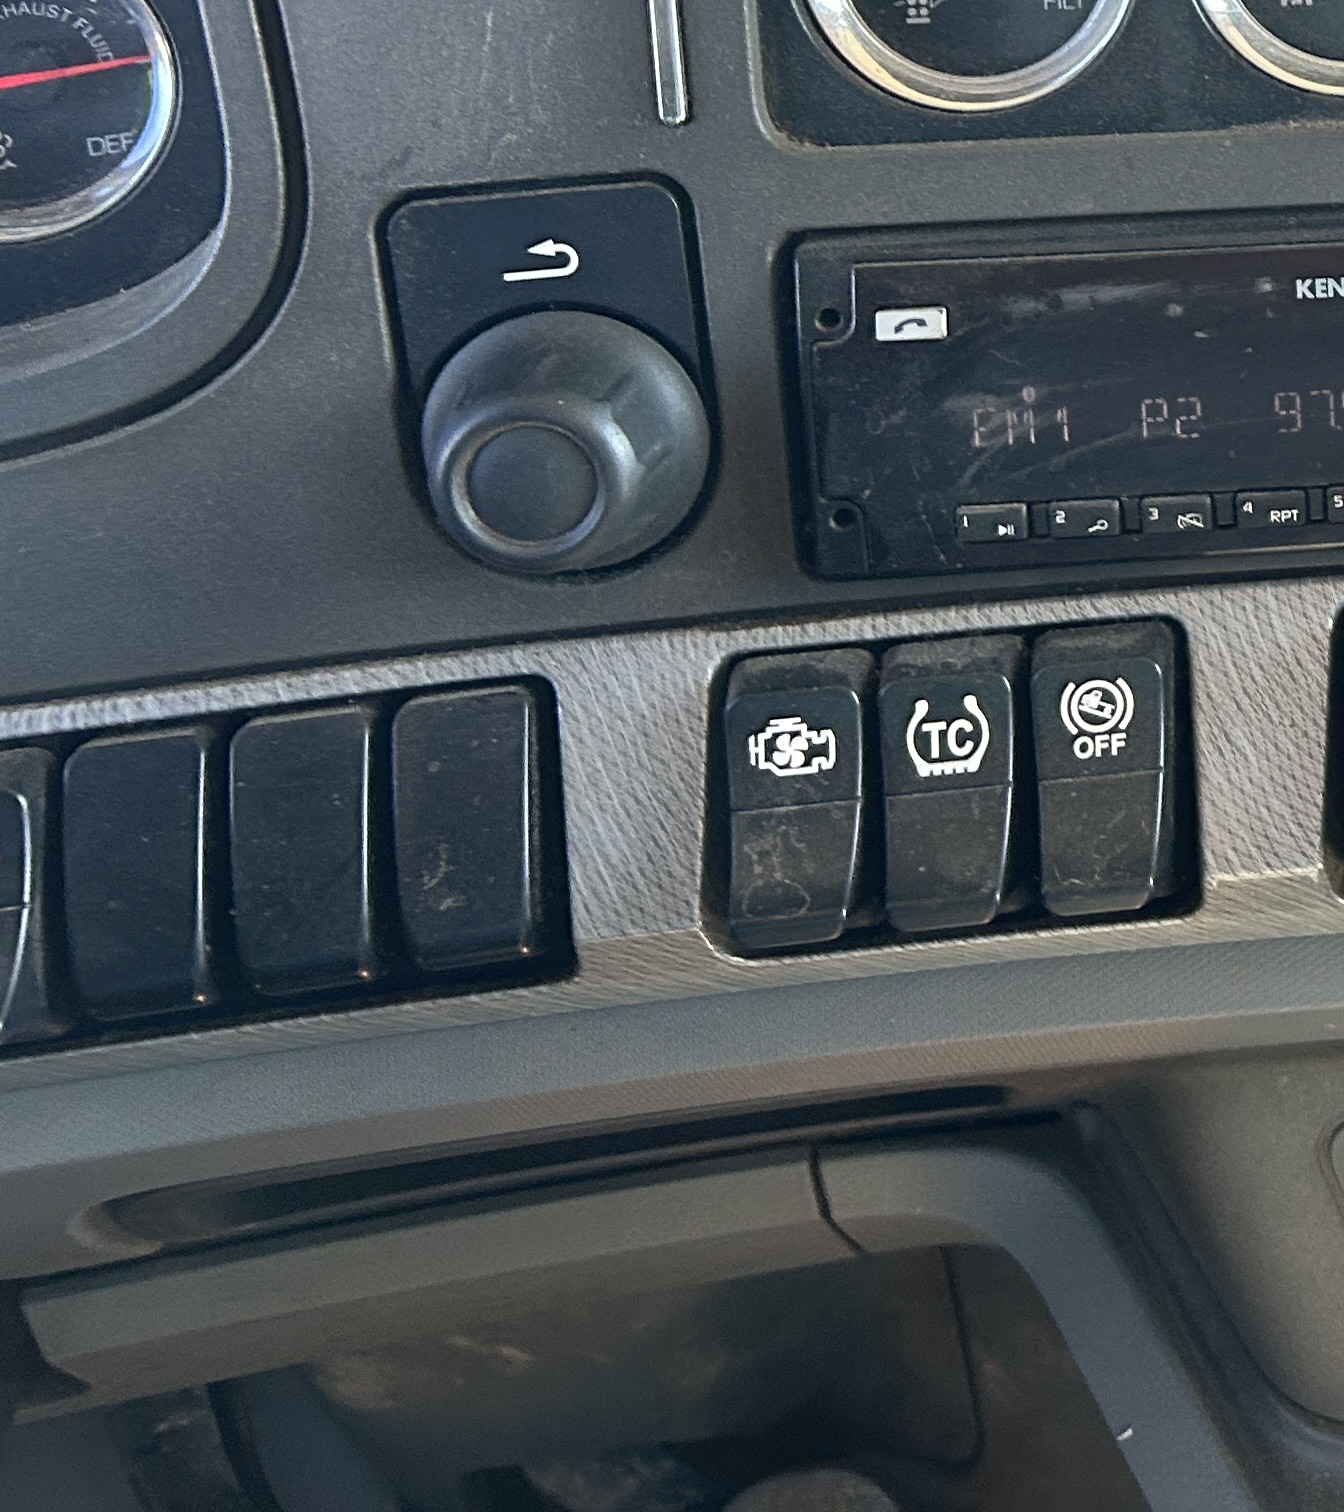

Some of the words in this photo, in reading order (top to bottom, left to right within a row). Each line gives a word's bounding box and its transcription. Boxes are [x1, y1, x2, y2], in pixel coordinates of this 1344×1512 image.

[86, 131, 134, 157] DEF
[1141, 396, 1202, 439] P2
[1148, 507, 1159, 520] 3
[1242, 501, 1253, 514] 4
[1270, 509, 1299, 523] RPT
[1333, 495, 1344, 508] 5
[1055, 510, 1066, 524] 2
[922, 719, 974, 759] TC
[1073, 731, 1127, 760] OFF
